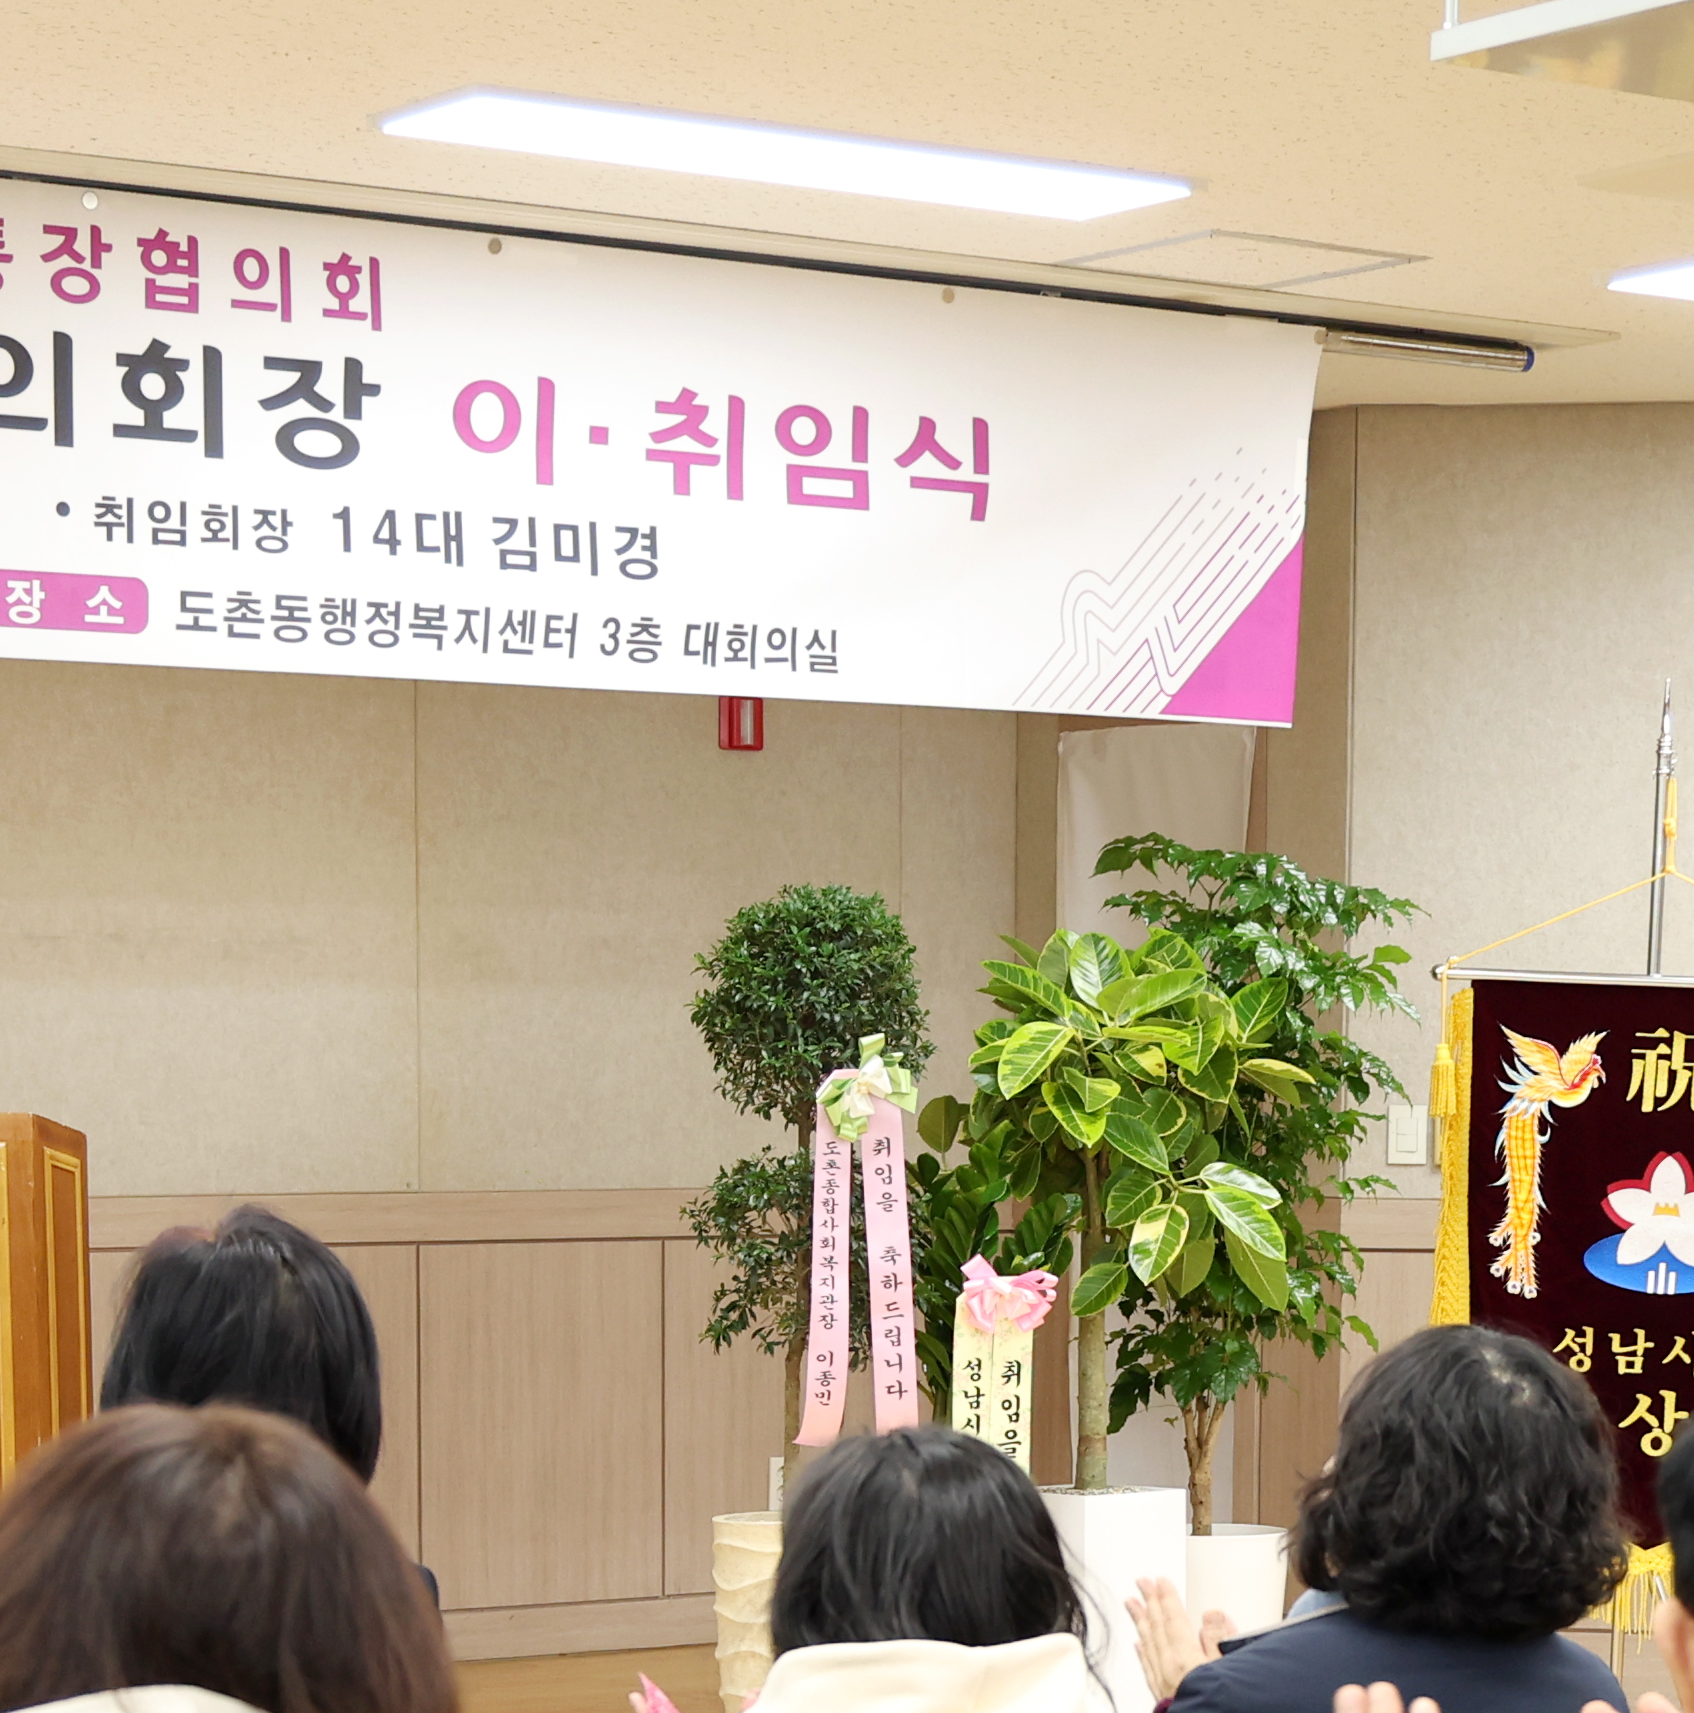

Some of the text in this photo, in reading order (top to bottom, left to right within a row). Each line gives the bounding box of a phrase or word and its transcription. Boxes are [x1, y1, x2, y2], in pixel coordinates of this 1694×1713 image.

[452, 376, 992, 523] 이·취임식
[94, 496, 658, 580] 취임회장 14대 김미경
[176, 591, 838, 673] 도촌동행정복지센터 3층 대회의실
[814, 1141, 841, 1406] 도촌종합사회복지관장 이종민
[873, 1137, 909, 1401] 취임을 축하드립니다
[1617, 1390, 1690, 1457] 상
